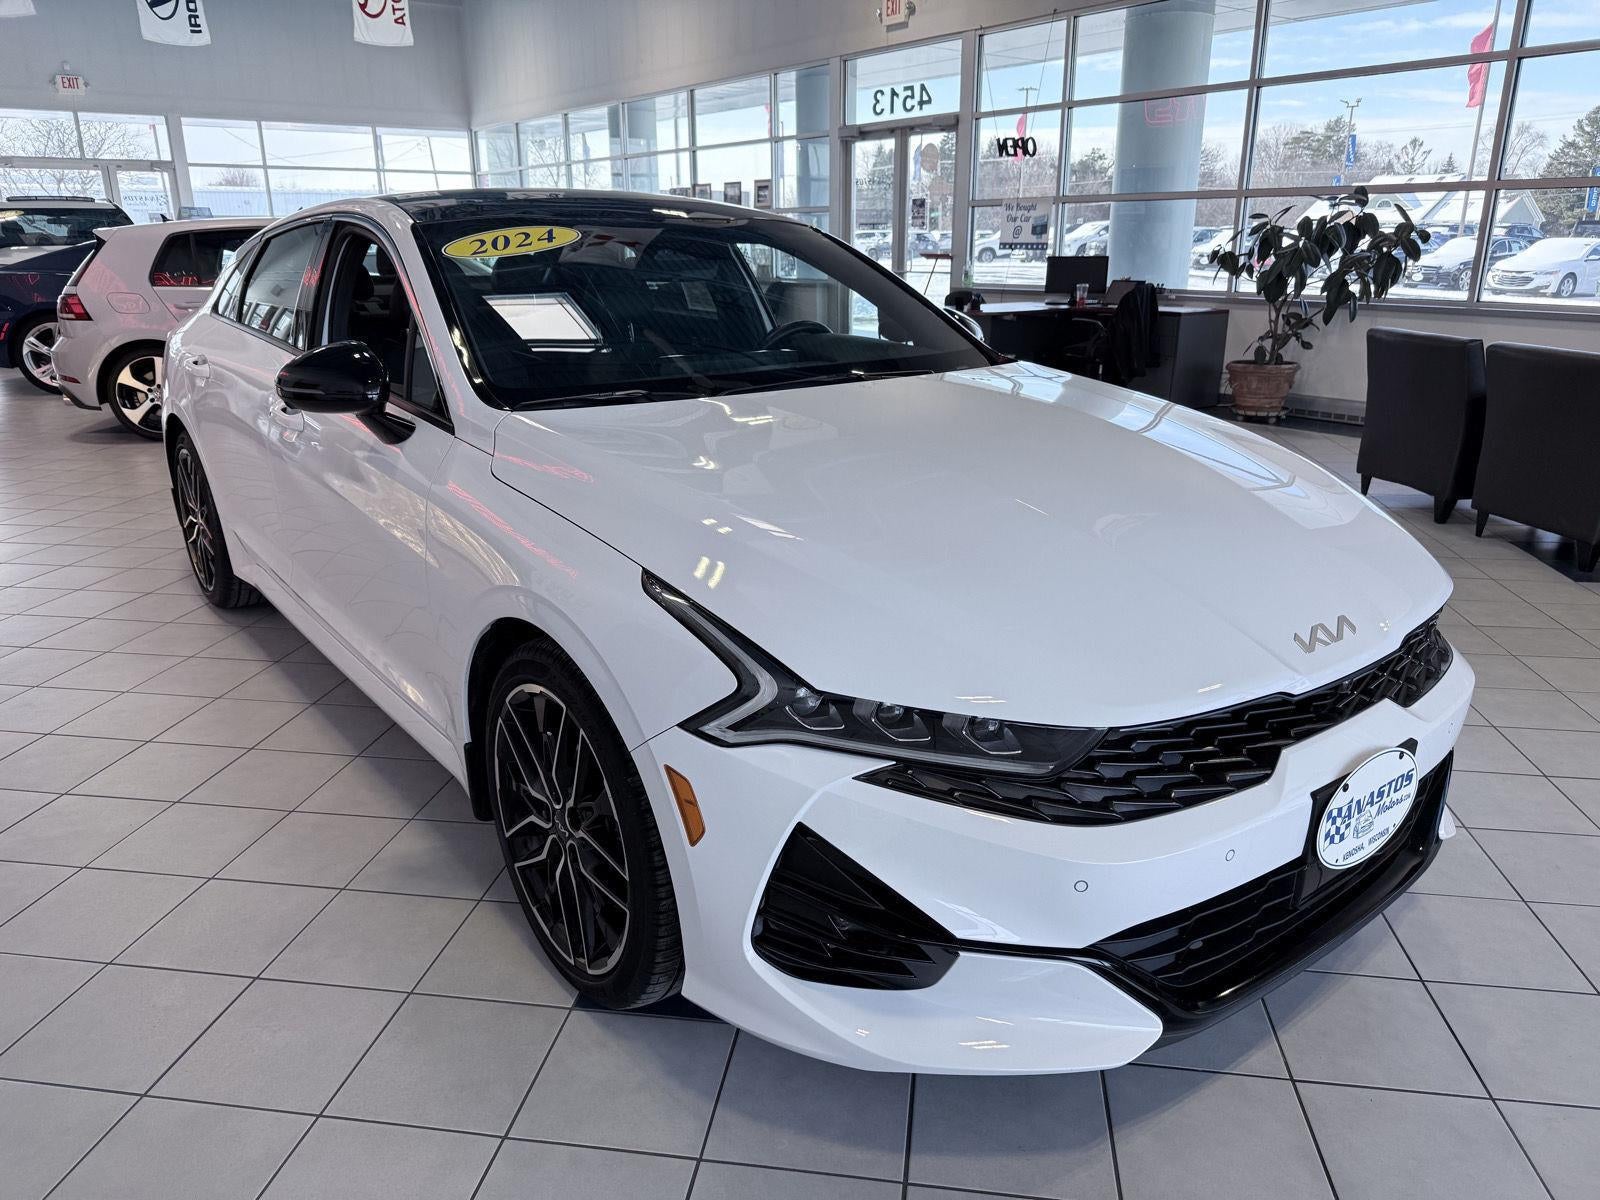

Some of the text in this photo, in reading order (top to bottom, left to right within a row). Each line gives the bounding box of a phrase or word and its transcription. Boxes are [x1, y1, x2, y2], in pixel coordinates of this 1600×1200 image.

[61, 76, 79, 89] EXIT
[1005, 202, 1037, 213] We Bought
[1007, 214, 1031, 222] Our Car
[1013, 225, 1022, 239] @
[469, 228, 556, 255] 2024
[1293, 614, 1356, 654] KIA
[1340, 767, 1415, 826] ANASTOS
[1368, 826, 1389, 846] WISCONSIN
